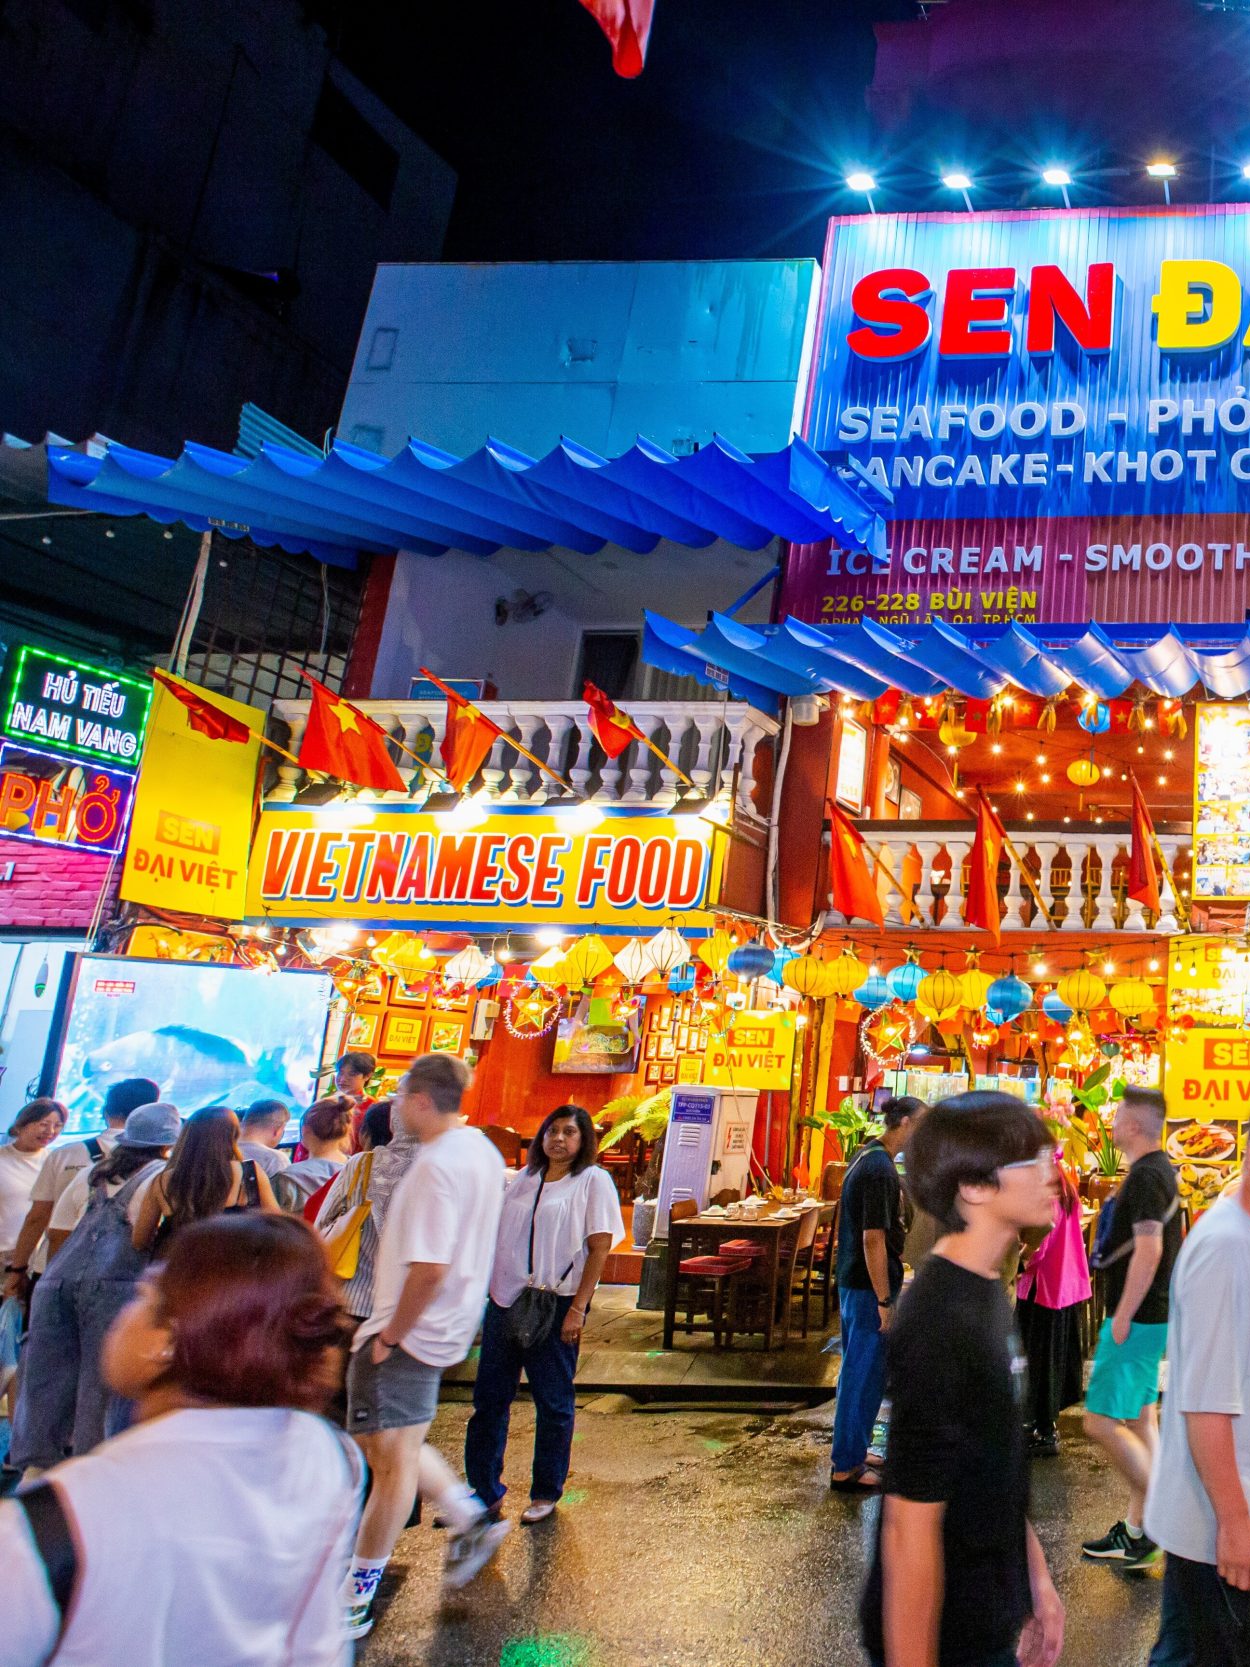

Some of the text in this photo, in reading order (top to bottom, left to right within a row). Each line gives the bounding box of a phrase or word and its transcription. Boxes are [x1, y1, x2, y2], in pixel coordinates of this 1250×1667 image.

[847, 263, 1116, 362] SEN
[839, 403, 1085, 441] SEAFOOD
[903, 545, 1042, 574] CREAM
[821, 586, 1038, 613] 226-228 BÙI VIỆN
[42, 670, 127, 718] HỦ TIẾU
[11, 702, 137, 757] NAM VANG
[0, 772, 121, 843] PHỞ
[161, 816, 215, 850] SEN
[134, 848, 238, 894] ĐẠI VIỆT
[260, 829, 707, 908] VIETNAMESE FOOD
[733, 1028, 769, 1045] SEN
[747, 1050, 786, 1072] VIỆT
[1183, 1079, 1230, 1108] ĐẠI
